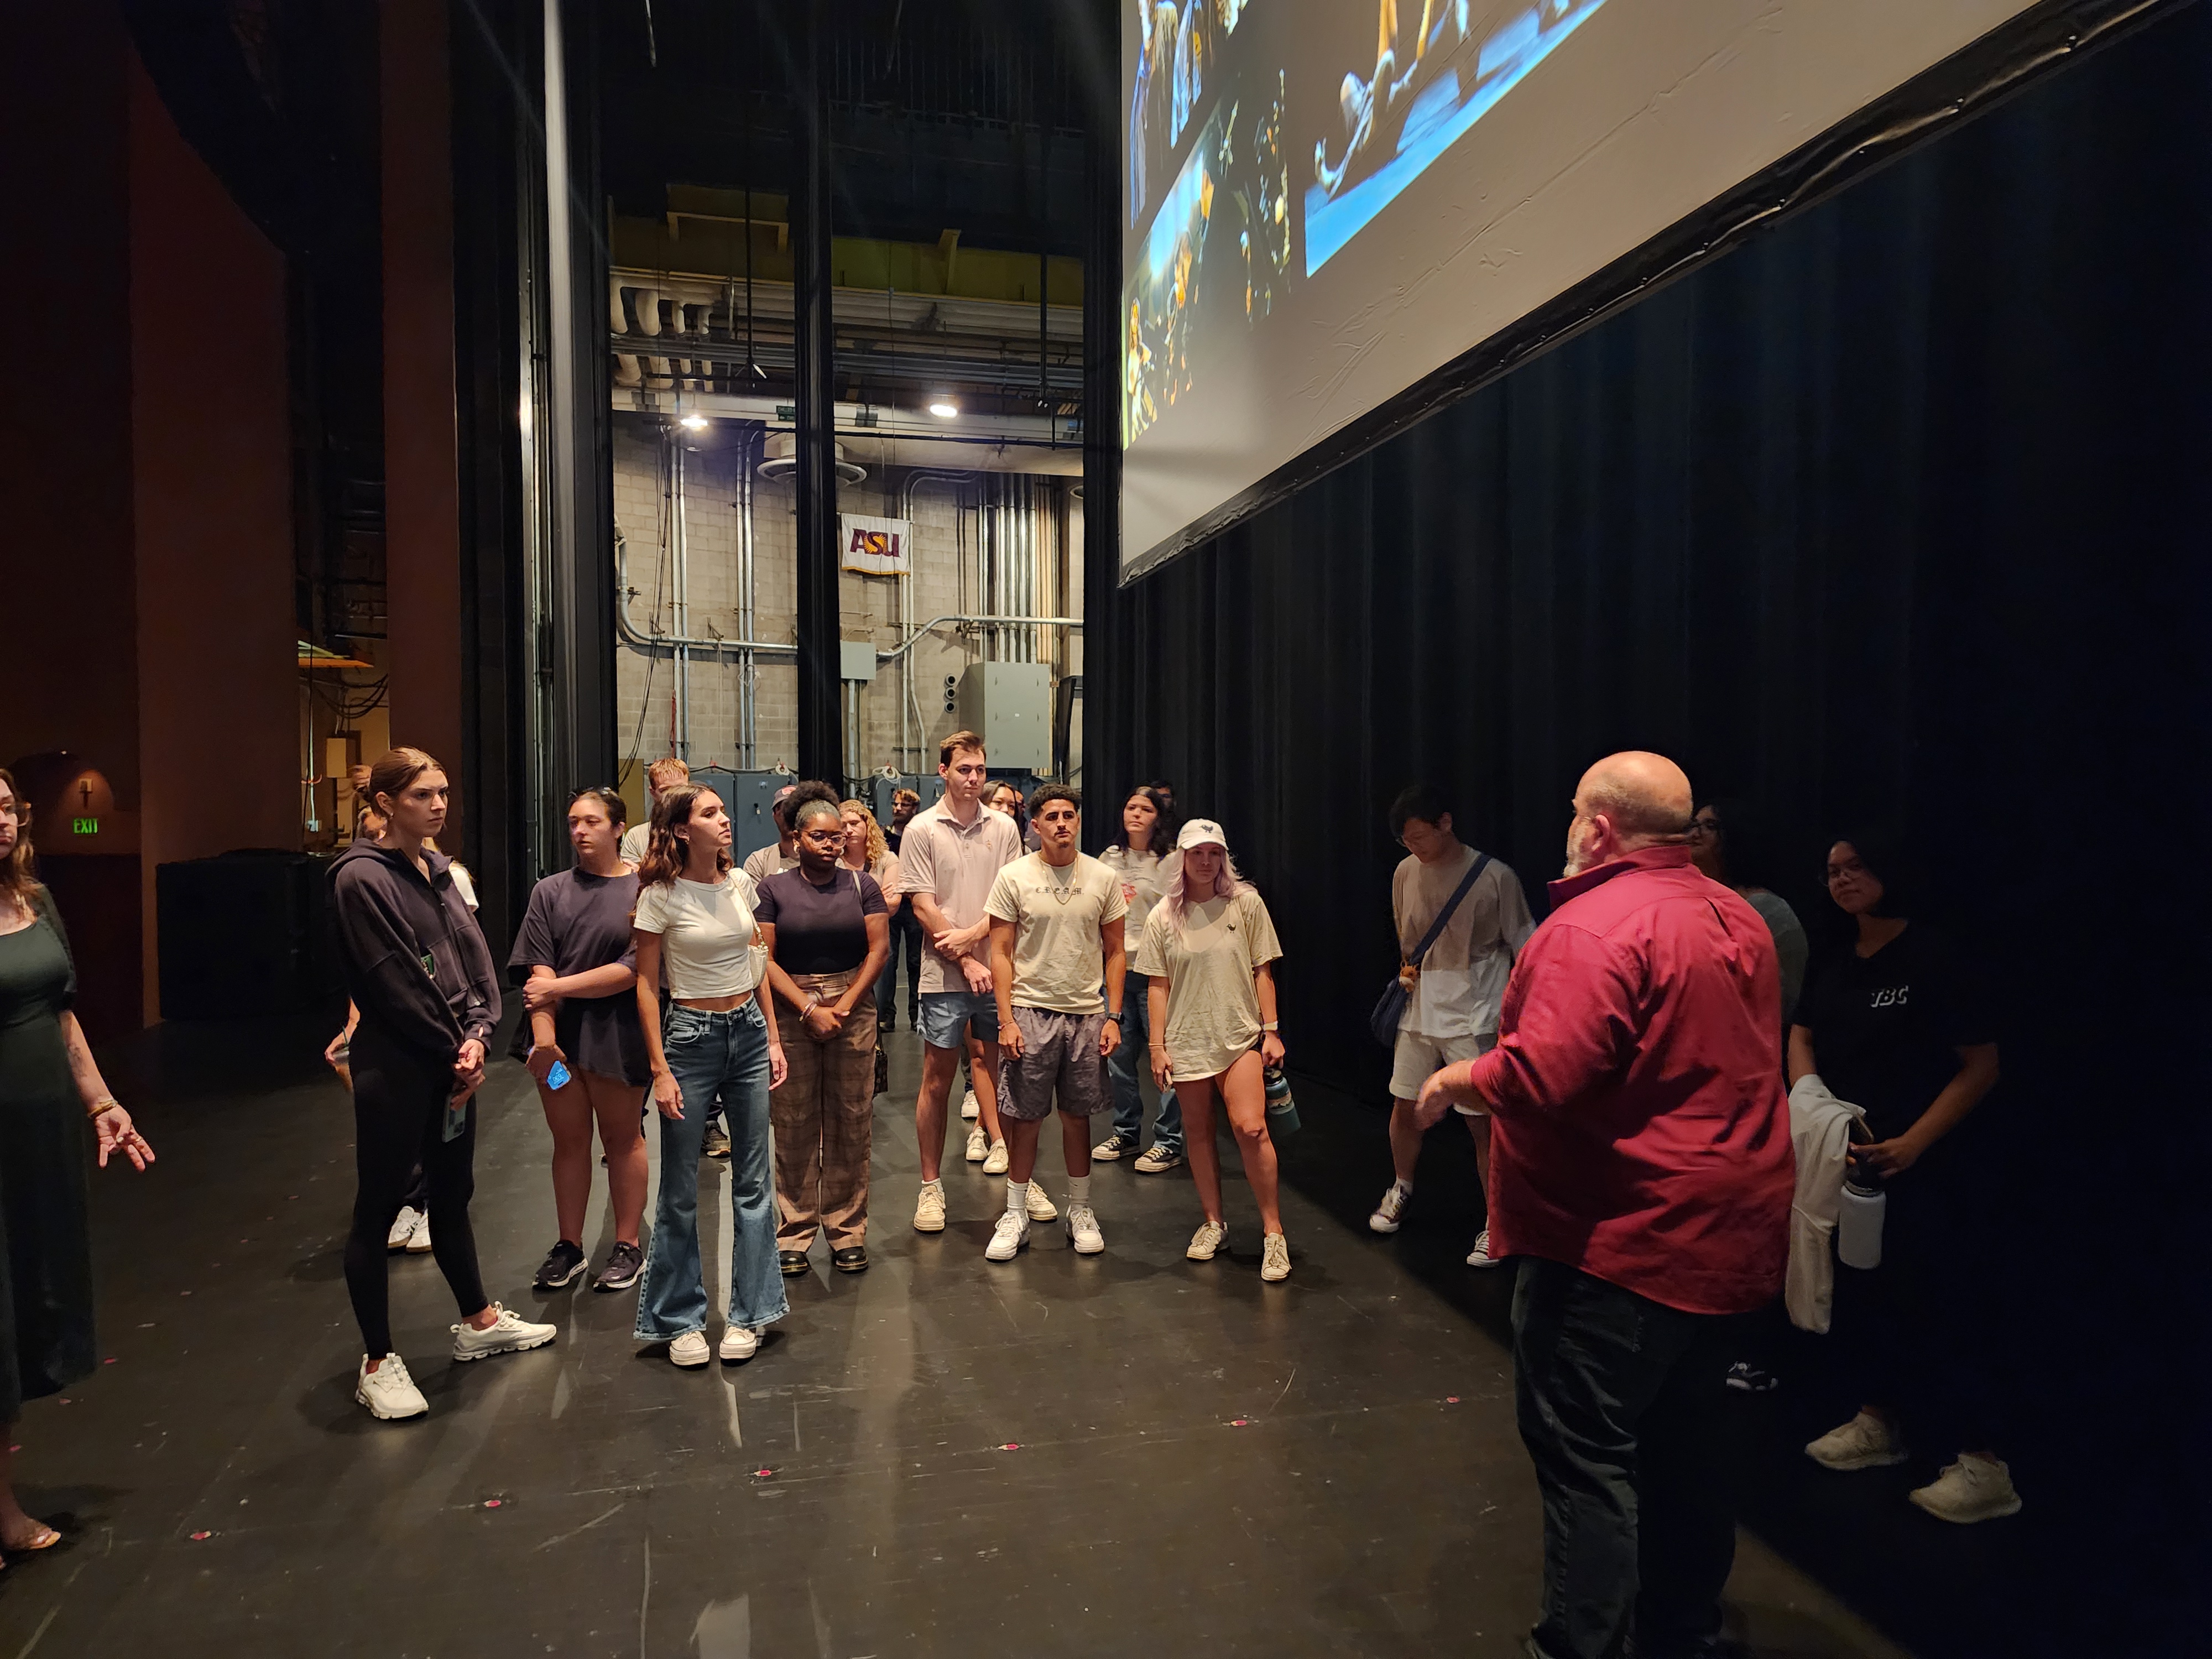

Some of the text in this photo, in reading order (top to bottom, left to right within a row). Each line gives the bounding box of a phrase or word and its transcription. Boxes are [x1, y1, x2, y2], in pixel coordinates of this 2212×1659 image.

[850, 528, 901, 559] ASU
[74, 818, 98, 834] EXIT
[1035, 886, 1084, 895] C.R.E.AM.
